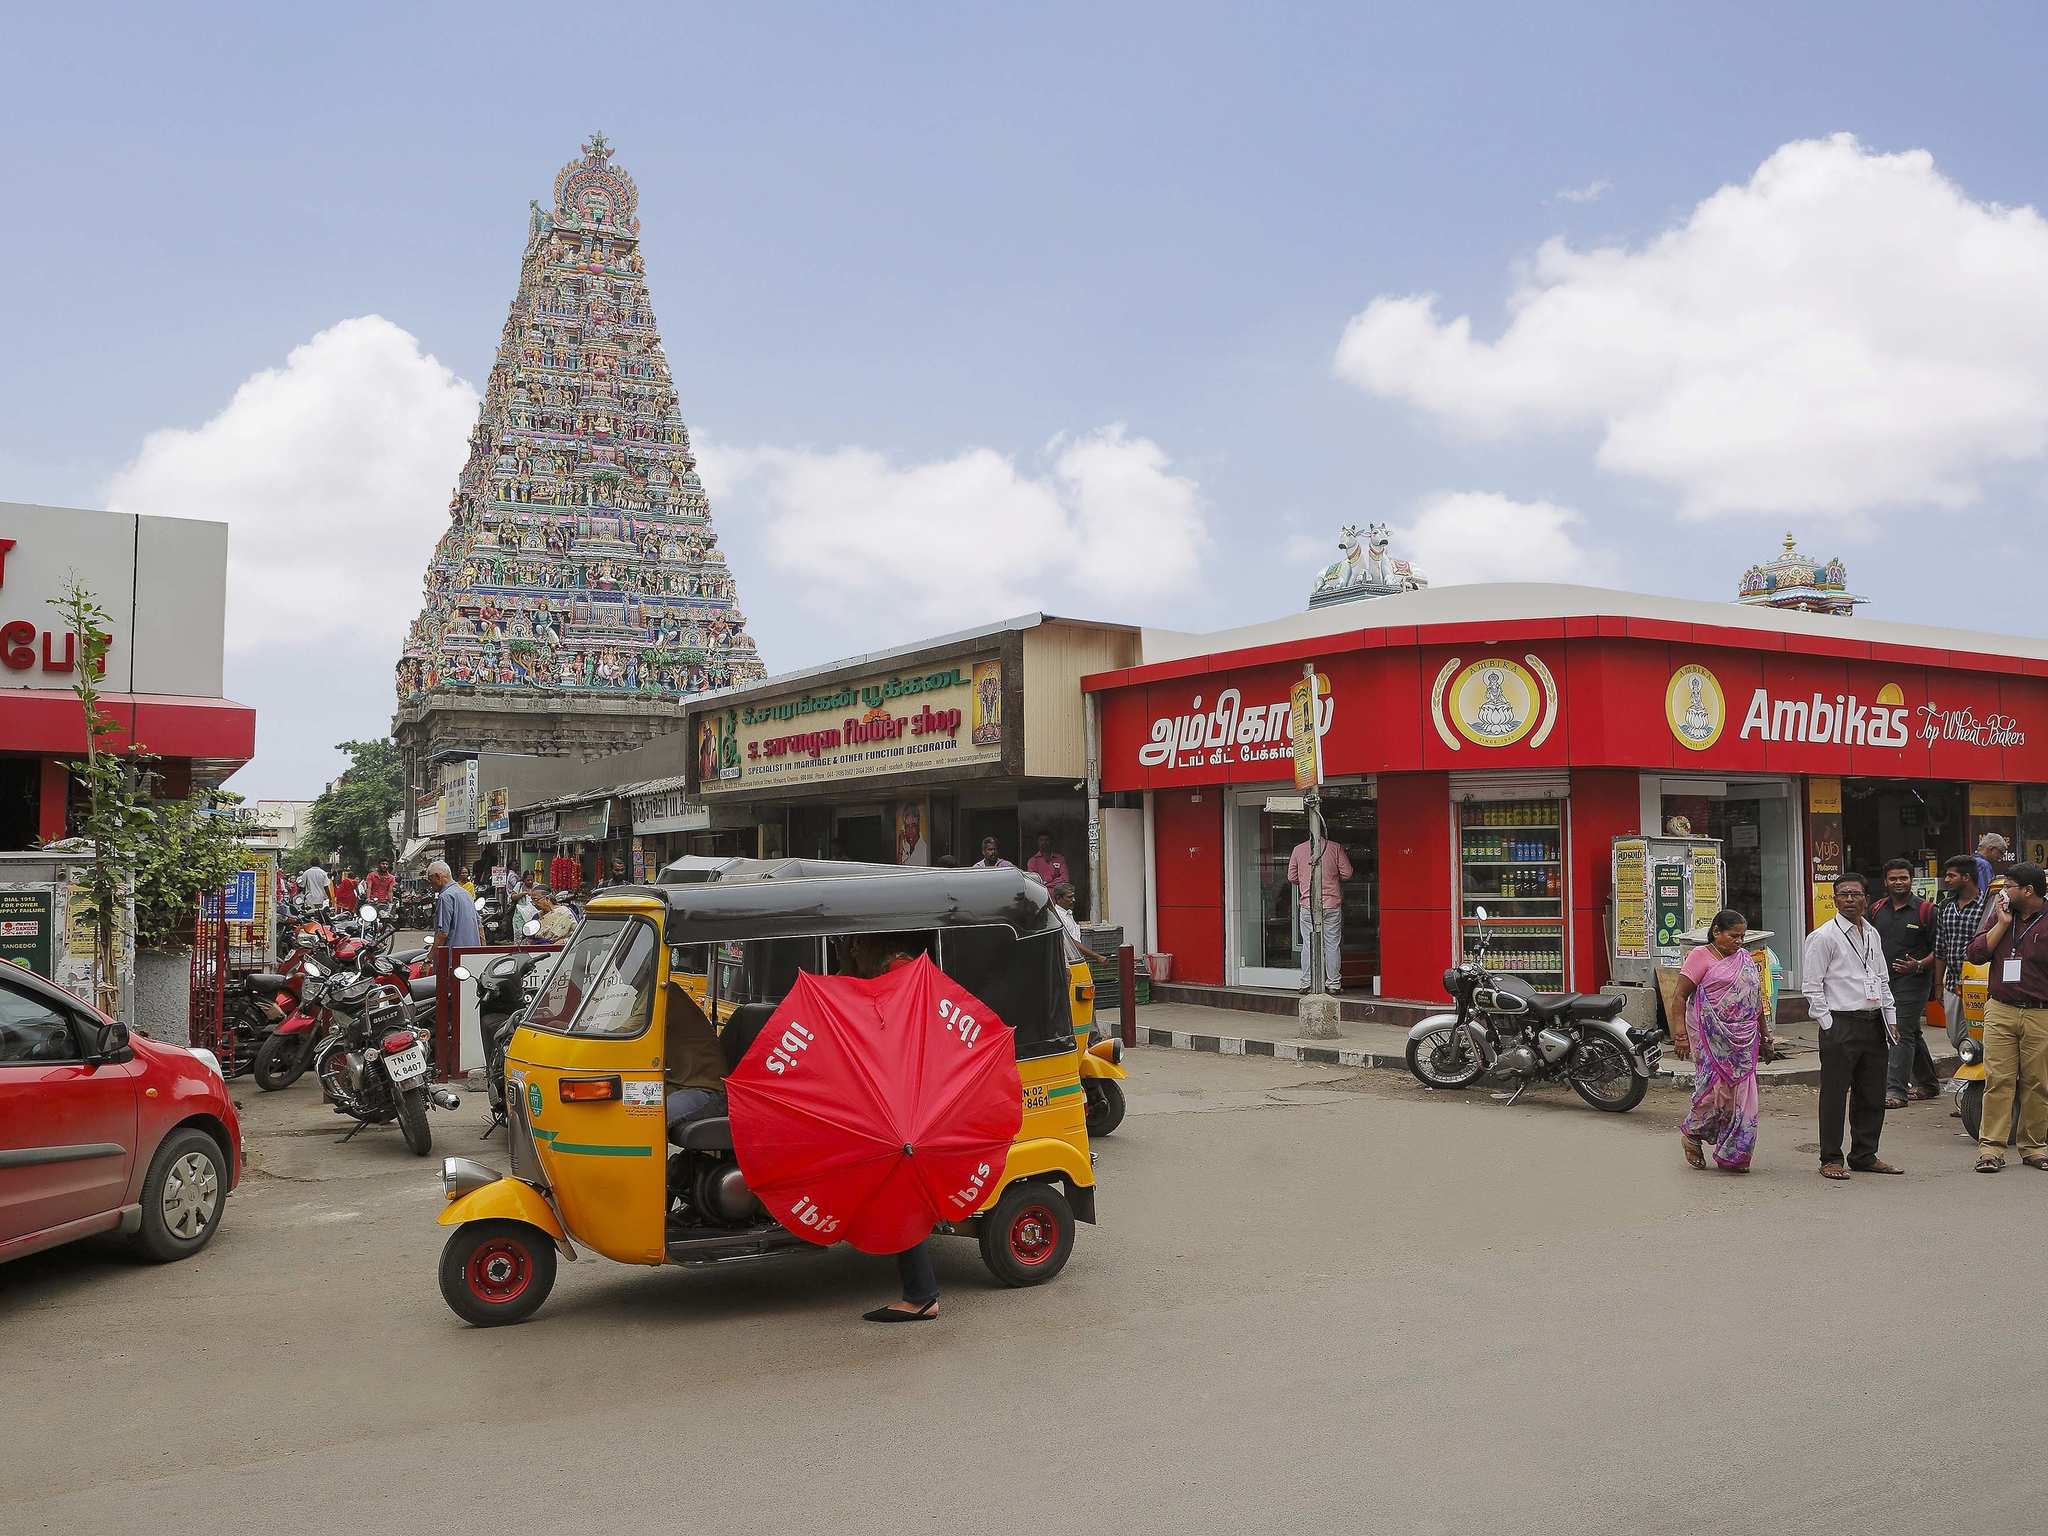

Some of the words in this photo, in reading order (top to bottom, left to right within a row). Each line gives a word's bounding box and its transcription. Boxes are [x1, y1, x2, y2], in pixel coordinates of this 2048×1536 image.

[763, 728, 841, 758] sarangan
[843, 716, 908, 746] flower
[911, 704, 962, 738] shop
[1740, 688, 1908, 747] Ambikas
[1915, 704, 1939, 749] Top
[1940, 706, 1982, 745] Wheat
[1980, 713, 2026, 747] Bakers
[748, 763, 783, 776] SPECIALIST
[784, 763, 792, 771] IN
[794, 757, 831, 771] MARRIAGE
[840, 752, 863, 764] OTHER
[865, 747, 904, 760] FUNCTION
[907, 740, 957, 755] DECORATOR
[468, 772, 476, 830] ARAVINDH
[373, 1011, 398, 1024] BULLET
[938, 998, 982, 1049] ibis
[391, 1055, 405, 1066] TN
[405, 1051, 417, 1060] 06
[765, 1021, 814, 1075] ibis
[393, 1068, 402, 1078] K
[402, 1062, 422, 1075] 8407
[1032, 1086, 1043, 1096] 02
[948, 1162, 991, 1208] ibis
[791, 1196, 840, 1233] ibis
